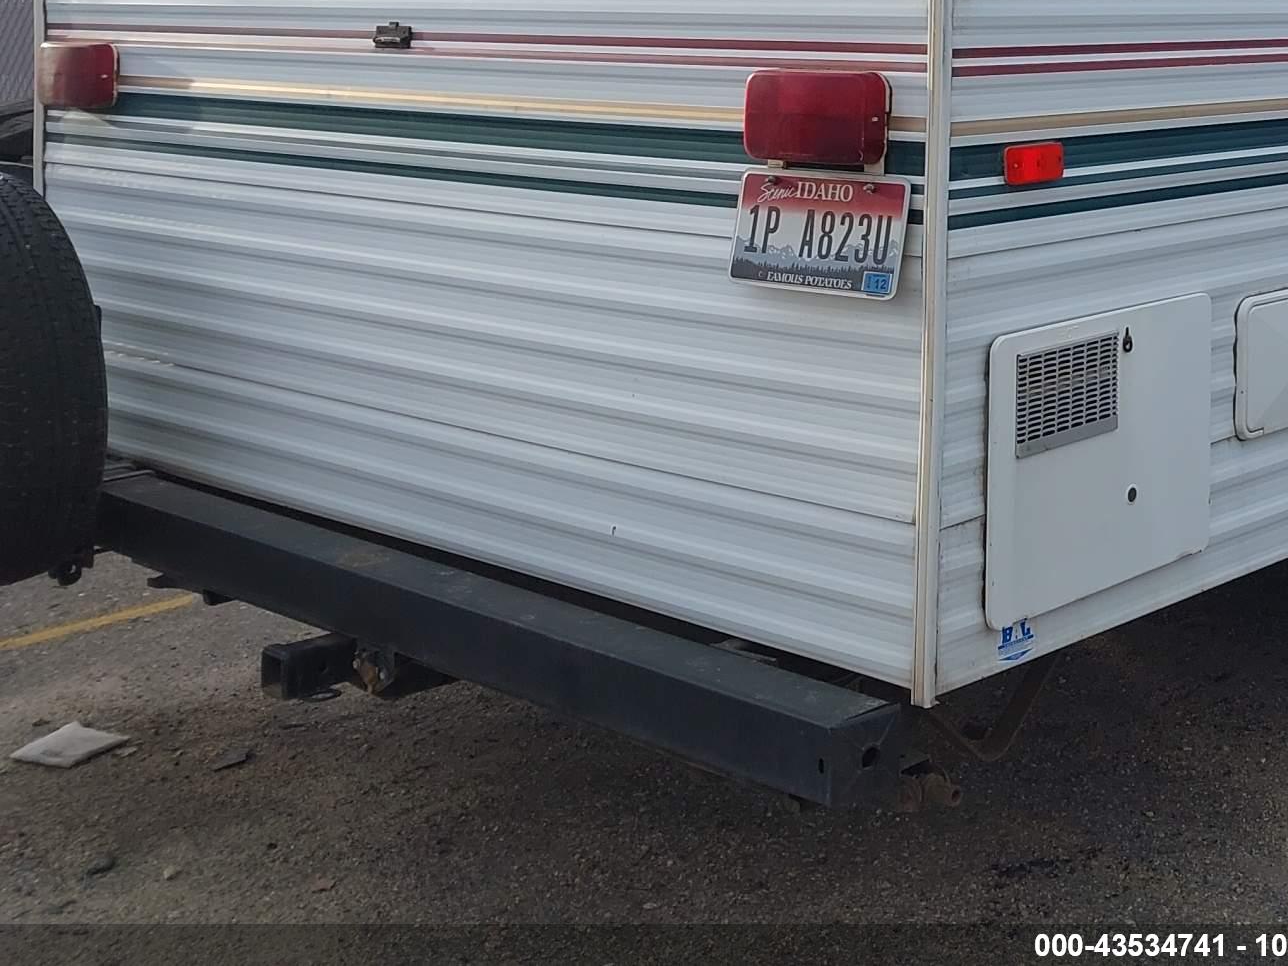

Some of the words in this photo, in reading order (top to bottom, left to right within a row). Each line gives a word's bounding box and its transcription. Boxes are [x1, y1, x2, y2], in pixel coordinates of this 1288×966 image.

[795, 181, 854, 203] IDAHO
[744, 205, 781, 254] 1P
[798, 209, 893, 266] A823U
[766, 271, 804, 284] FAMOUS
[804, 275, 852, 290] POTATOES
[875, 278, 888, 290] 12
